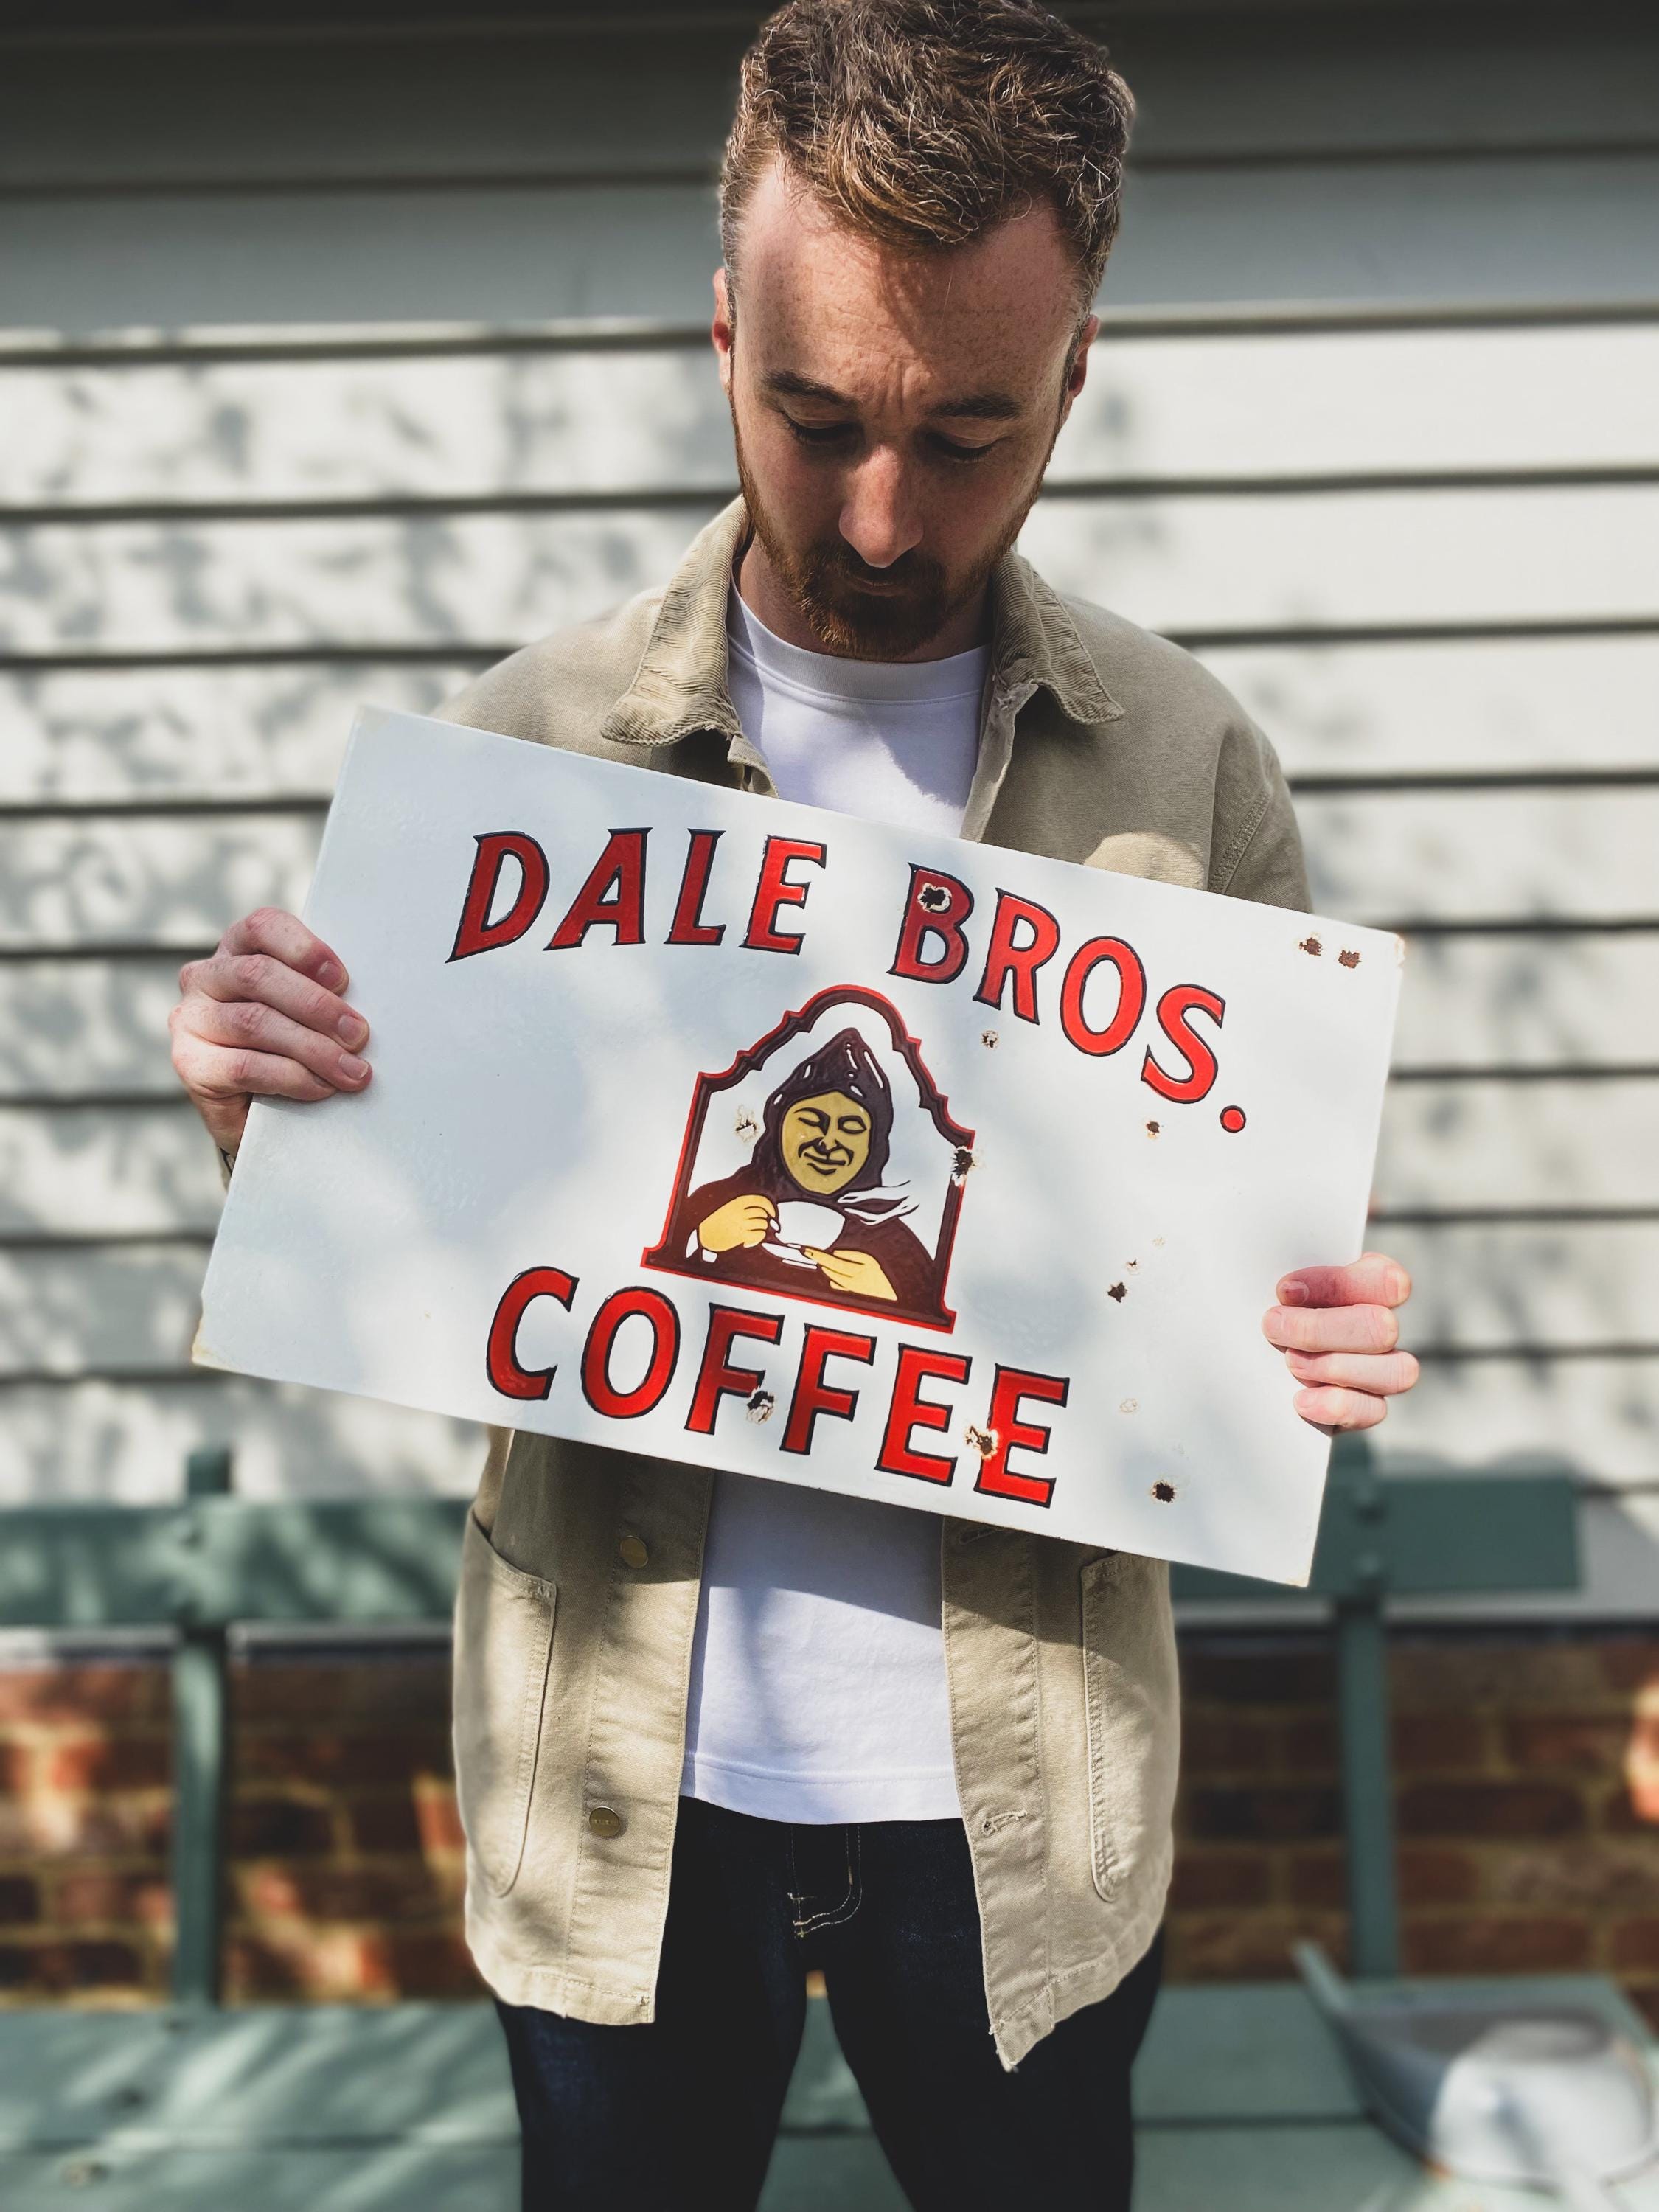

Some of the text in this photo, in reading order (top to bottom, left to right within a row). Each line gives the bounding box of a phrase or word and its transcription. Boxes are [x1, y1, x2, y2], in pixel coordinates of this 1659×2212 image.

[445, 827, 1246, 1133] DALE BROS.
[486, 1266, 1070, 1509] COFFEE
